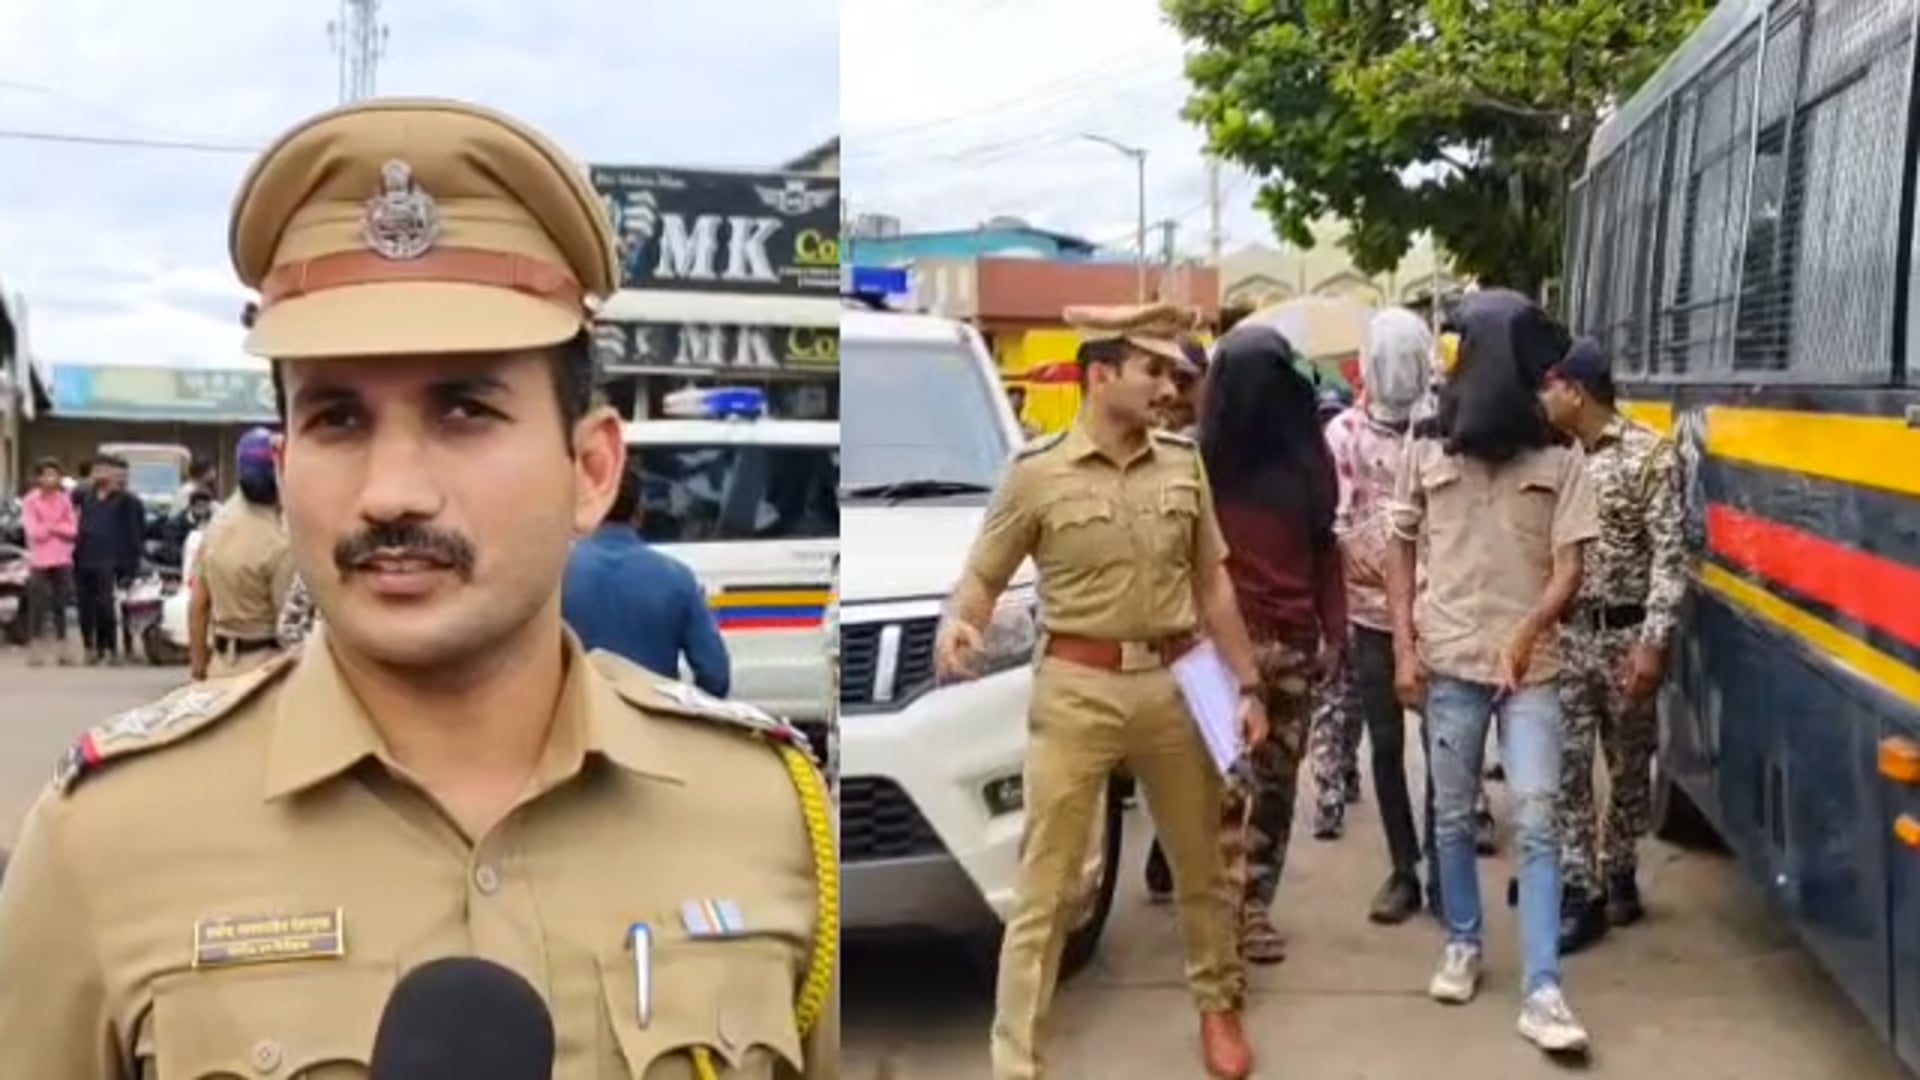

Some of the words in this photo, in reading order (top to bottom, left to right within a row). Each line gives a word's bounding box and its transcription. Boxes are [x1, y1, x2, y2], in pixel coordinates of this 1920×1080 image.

[653, 213, 783, 283] MK
[795, 228, 839, 262] Co
[673, 324, 780, 369] MK
[787, 326, 839, 356] Co
